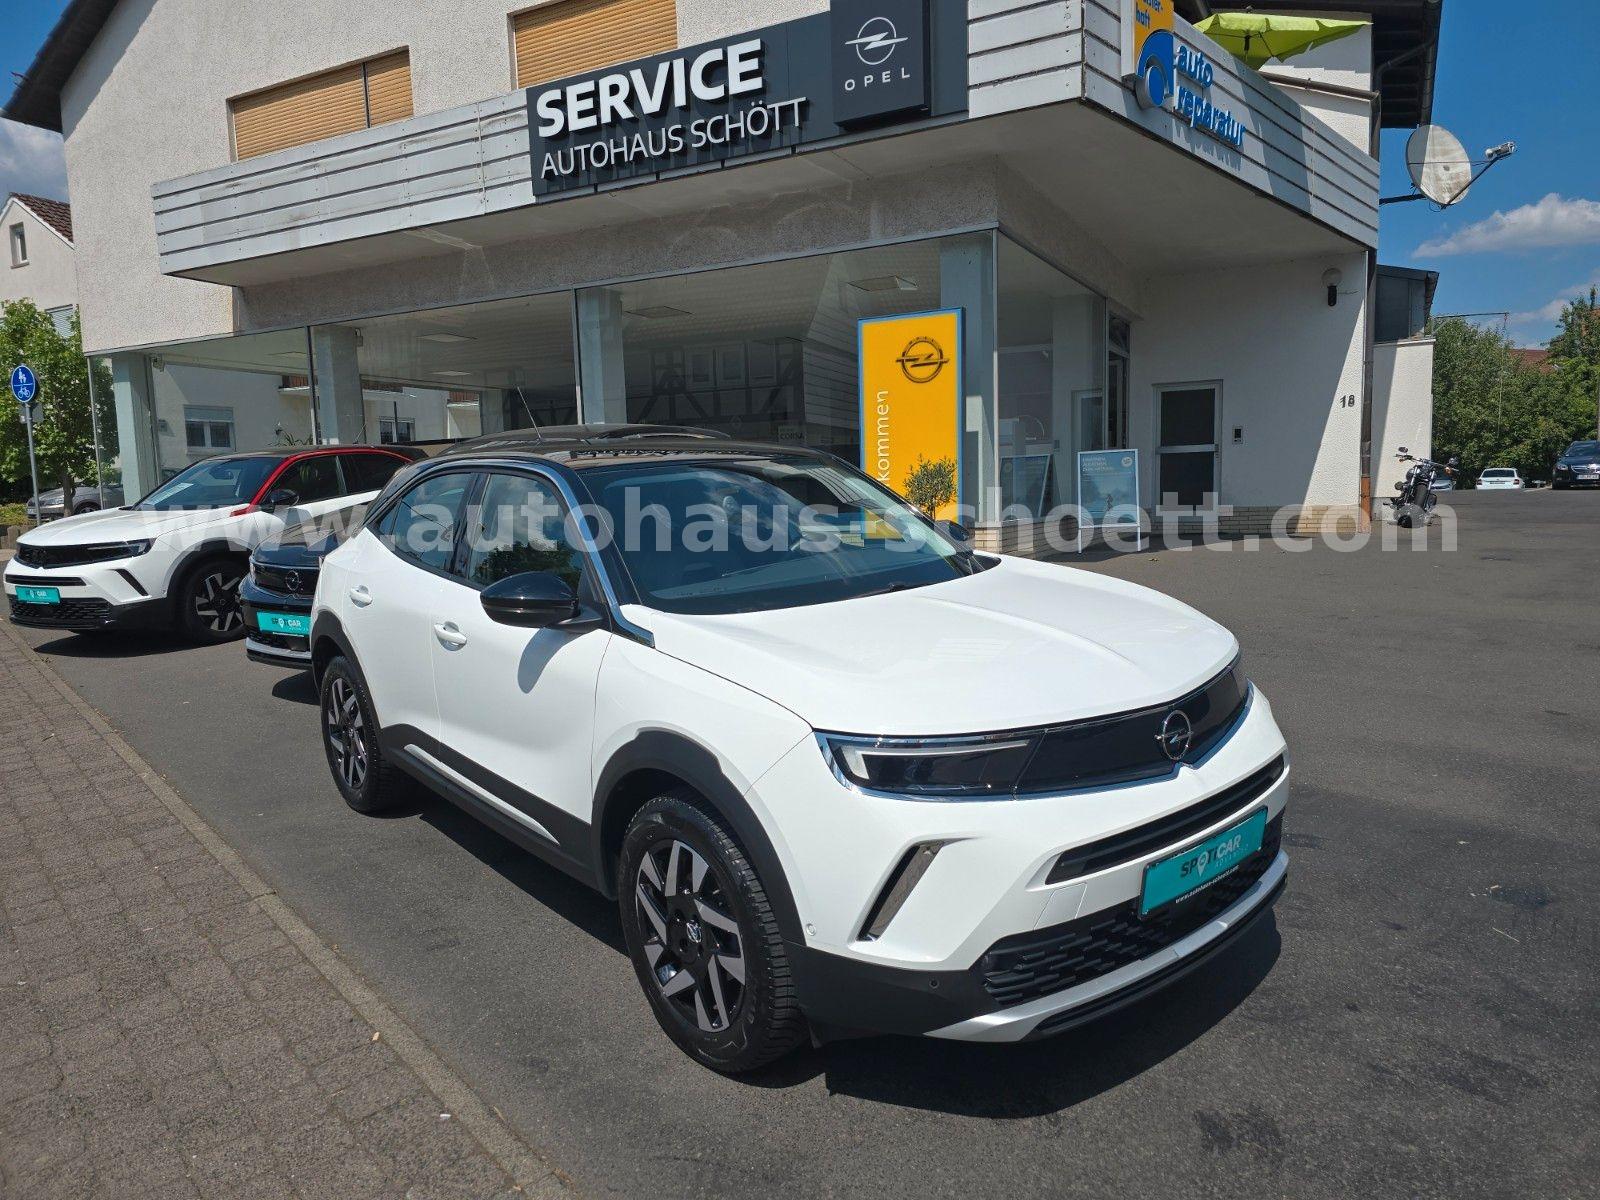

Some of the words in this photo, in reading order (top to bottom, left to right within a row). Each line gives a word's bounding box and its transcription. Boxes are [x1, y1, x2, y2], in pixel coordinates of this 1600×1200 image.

[538, 38, 763, 138] SERVICE
[844, 67, 911, 92] OPEL
[1175, 45, 1213, 88] auto
[541, 124, 684, 180] AUTOHAUS
[690, 97, 807, 148] SCHÖTT
[1175, 85, 1246, 147] reparatur
[1340, 394, 1355, 408] 18
[876, 390, 890, 488] kommen
